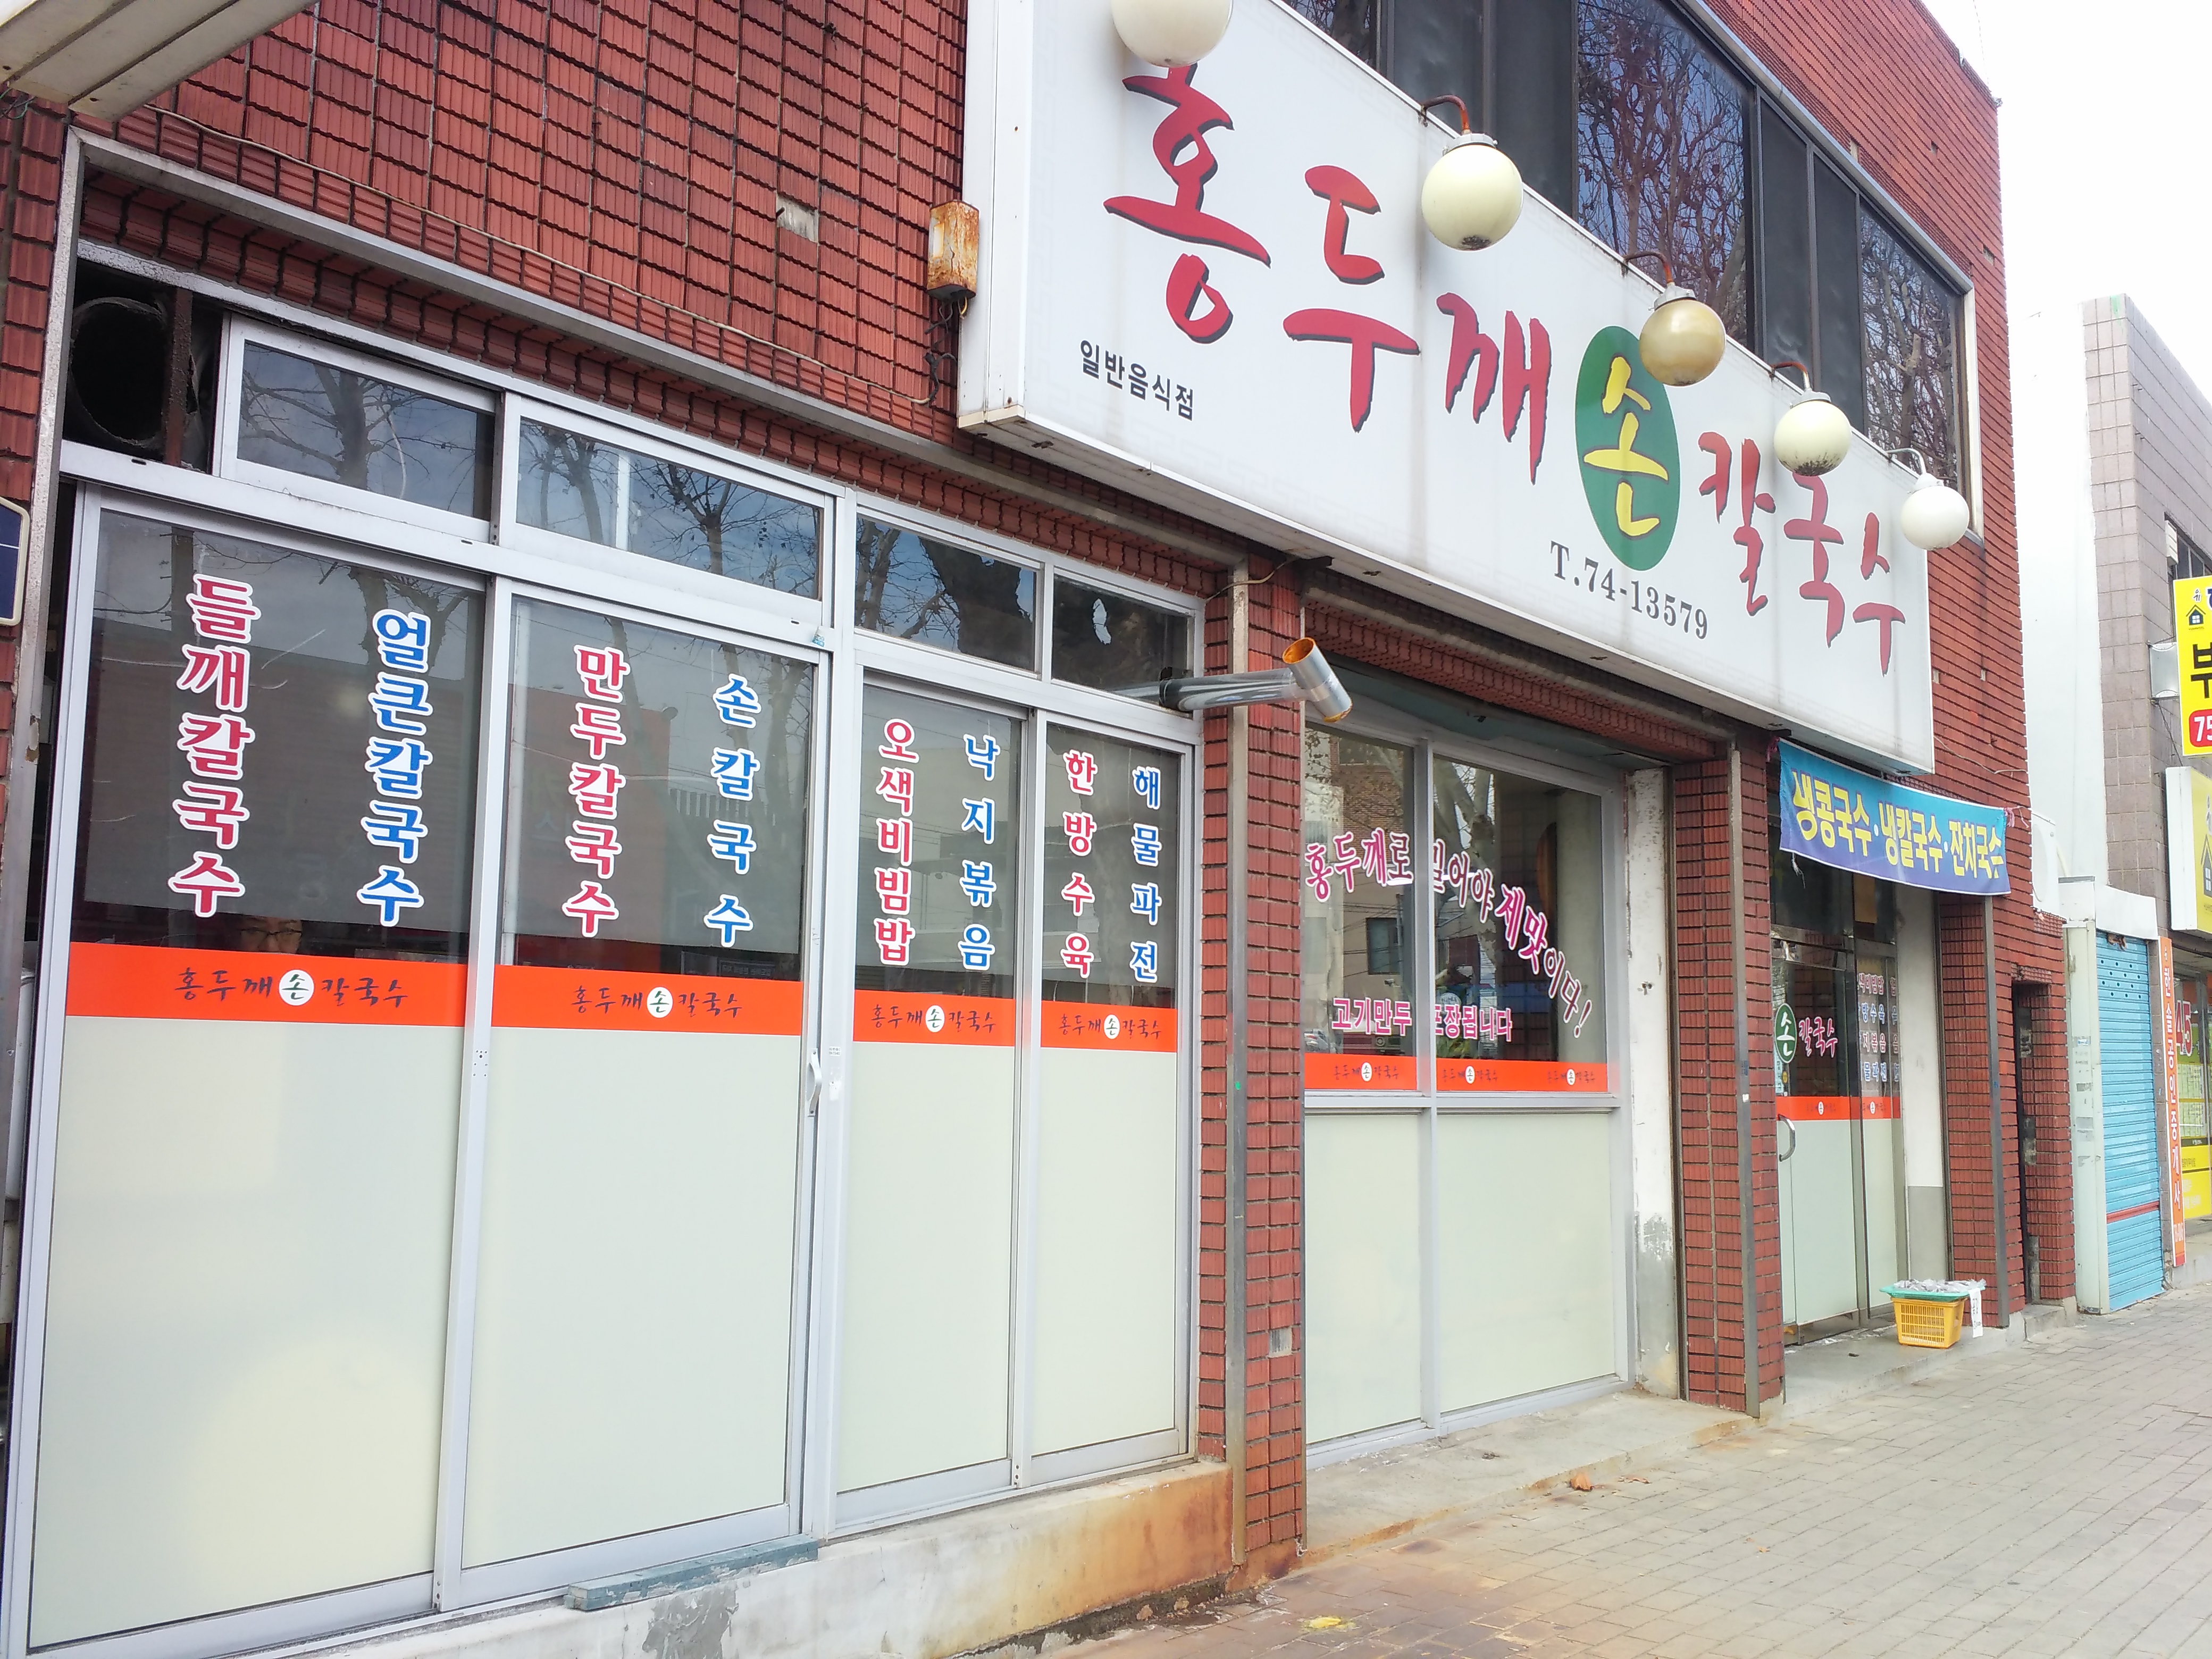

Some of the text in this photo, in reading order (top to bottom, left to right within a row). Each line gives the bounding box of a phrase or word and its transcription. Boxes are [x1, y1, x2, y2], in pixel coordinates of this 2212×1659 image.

[1080, 340, 1194, 421] 일반음식점
[1103, 63, 1906, 677] 홍두깨 손 칼국수
[168, 574, 261, 918] 들깨칼국수
[357, 609, 432, 926] 얼큰칼국수
[563, 645, 630, 937] 만두칼국수
[1793, 770, 2005, 879] 냉콩국수 냉칼국수 잔치국수
[874, 718, 919, 965] 오색비빔밥
[958, 734, 1000, 971] 낙지볶음
[1061, 749, 1097, 978] 한방수육
[1130, 766, 1162, 983] 해물파전
[175, 968, 408, 1008] 홍두깨 손 칼국수
[572, 985, 742, 1018] 홍두깨 손 칼국수
[1495, 884, 1591, 1038] 제맛이다!
[1857, 973, 1884, 995] 색비빔밥
[872, 1003, 996, 1033] 홍두깨 손 칼국수
[1104, 1015, 1119, 1037] 손
[1331, 997, 1412, 1036] 고기만두
[1798, 1016, 1838, 1058] 칼국수
[1859, 1002, 1885, 1024] 방수육
[1859, 1032, 1886, 1053] 지볶음
[1861, 1061, 1887, 1082] 물파전
